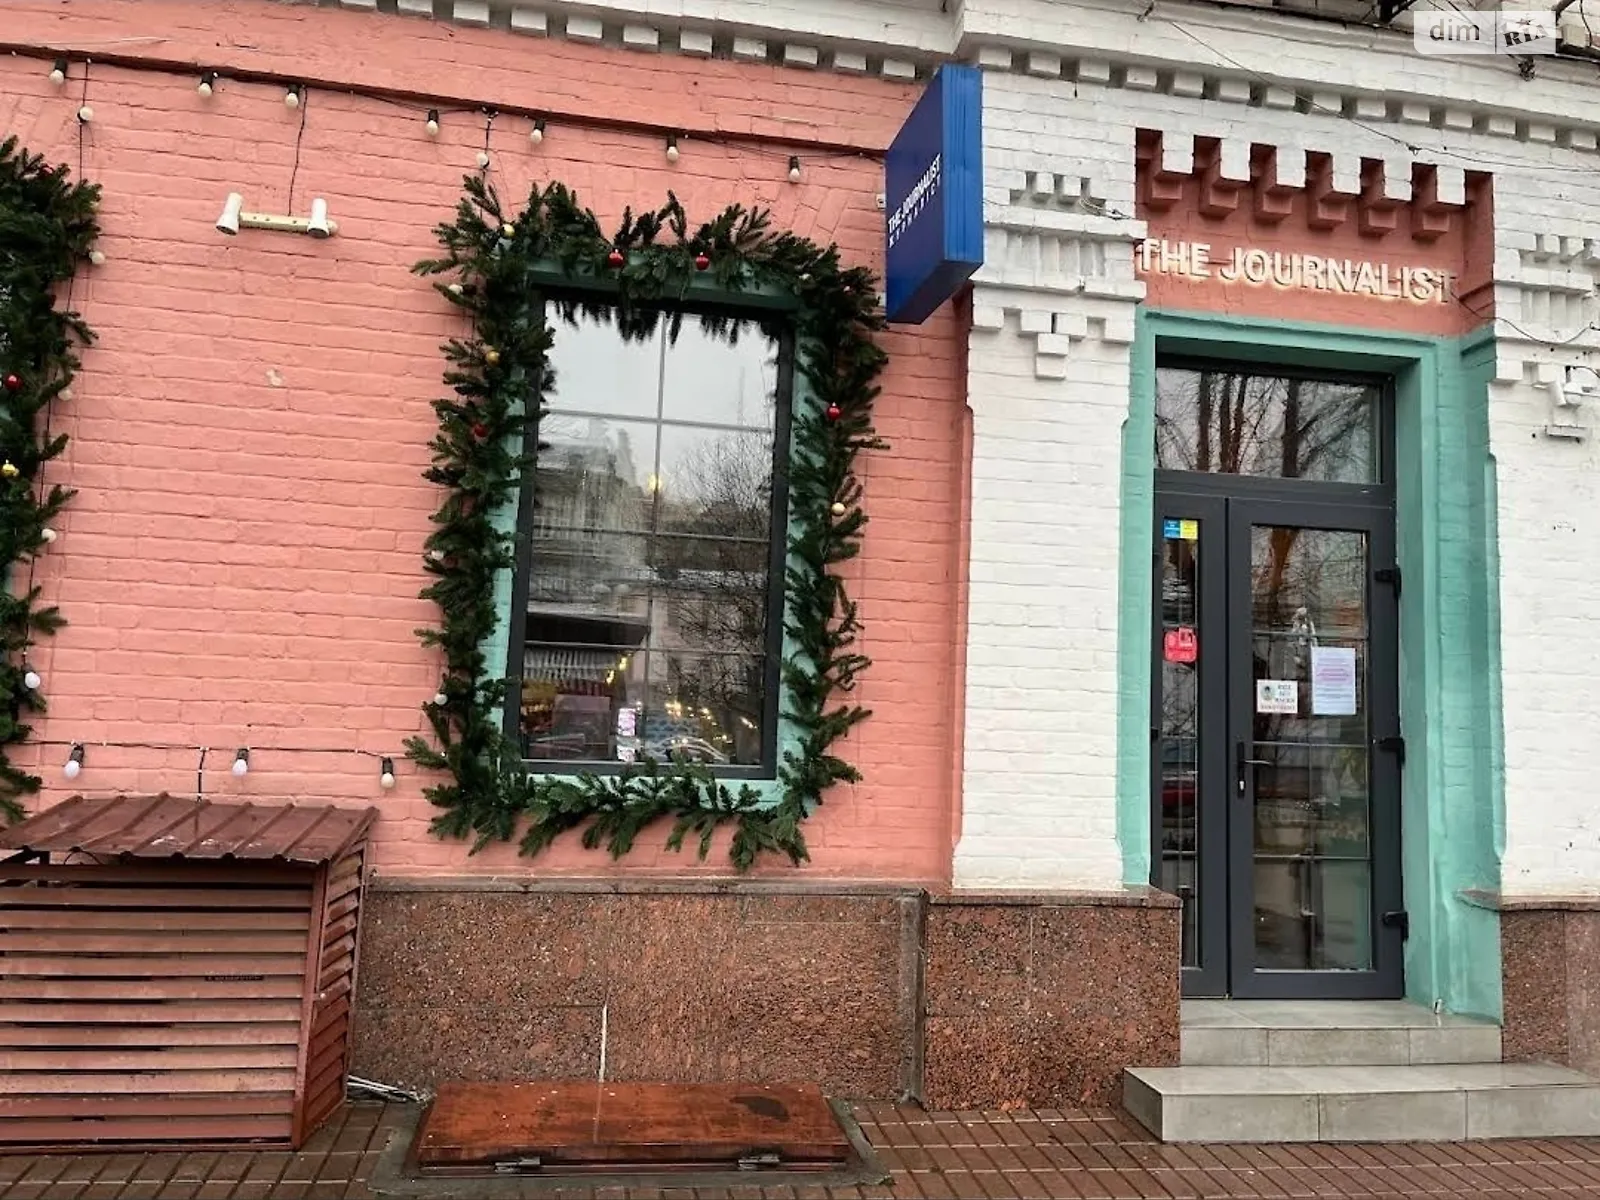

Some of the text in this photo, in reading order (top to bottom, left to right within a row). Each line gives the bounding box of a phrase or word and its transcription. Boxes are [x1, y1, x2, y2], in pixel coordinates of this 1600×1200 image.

[888, 152, 941, 235] THE JOURNALIST
[1139, 238, 1455, 303] THE JOURNALIST
